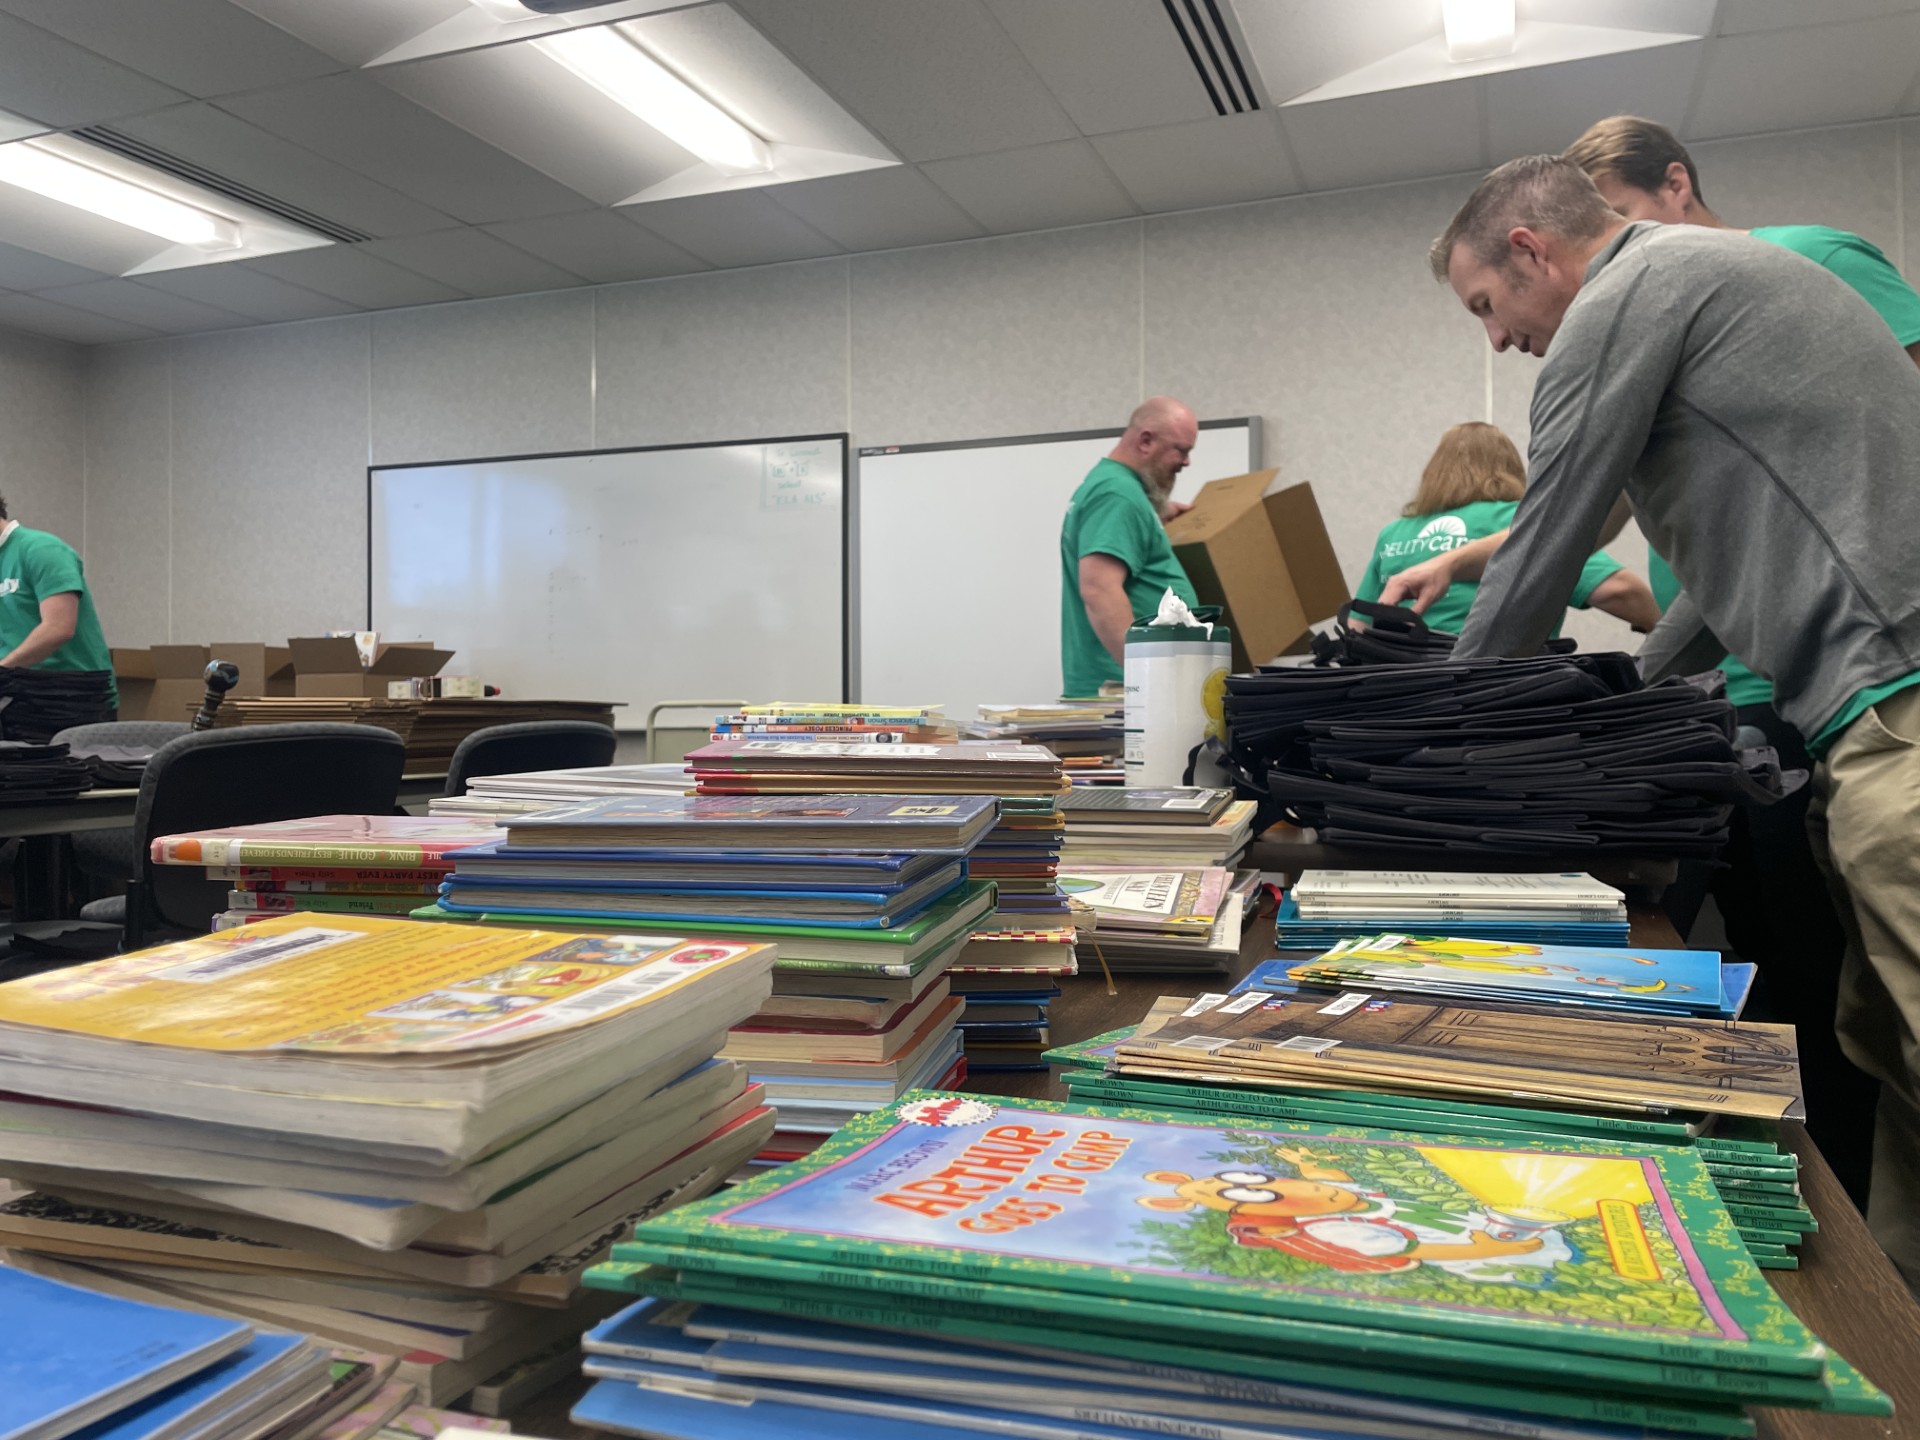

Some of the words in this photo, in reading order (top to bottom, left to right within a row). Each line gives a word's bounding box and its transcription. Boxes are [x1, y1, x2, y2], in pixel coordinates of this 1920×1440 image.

[276, 849, 312, 859] FRIENDS
[312, 850, 332, 859] BEST
[389, 851, 416, 861] BINK
[356, 871, 379, 879] EVER
[384, 871, 413, 879] PARTY
[1094, 1078, 1125, 1087] BROWN
[1186, 1088, 1220, 1098] ARTHUR
[1222, 1091, 1245, 1100] GOES
[1248, 1095, 1260, 1103] TO
[1262, 1096, 1287, 1105] CAMP
[1103, 1089, 1134, 1099] BROWN
[1195, 1100, 1228, 1110] ARTHUR
[1232, 1103, 1255, 1112] GOES
[1259, 1105, 1270, 1113] TO
[1272, 1107, 1298, 1116] CAMP
[1596, 1119, 1626, 1130] Little,
[1627, 1123, 1656, 1133] Brown
[1050, 1129, 1134, 1172] CAMP
[1711, 1140, 1741, 1150] Brown
[1730, 1152, 1762, 1163] Brown
[871, 1125, 1066, 1218] ARTHUR
[1022, 1173, 1088, 1195] TO
[1738, 1192, 1769, 1202] Brown
[957, 1196, 1064, 1234] GOES
[1743, 1207, 1775, 1217] Brown
[1751, 1218, 1783, 1228] Brown
[687, 1235, 734, 1250] BROWN
[831, 1250, 884, 1266] ARTHUR
[888, 1256, 927, 1270] GOES
[929, 1259, 949, 1272] TO
[951, 1261, 994, 1277] CAMP
[667, 1254, 716, 1270] BROWN
[817, 1270, 872, 1287] ARTHUR
[876, 1276, 915, 1291] GOES
[917, 1281, 938, 1294] TO
[941, 1282, 987, 1301] CAMP
[634, 1280, 683, 1299] BROWN
[780, 1298, 833, 1315] ARTHUR
[901, 1311, 942, 1330] CAMP
[1715, 1346, 1769, 1368] Brown
[1716, 1371, 1770, 1392] Brown
[1646, 1406, 1698, 1427] Brown
